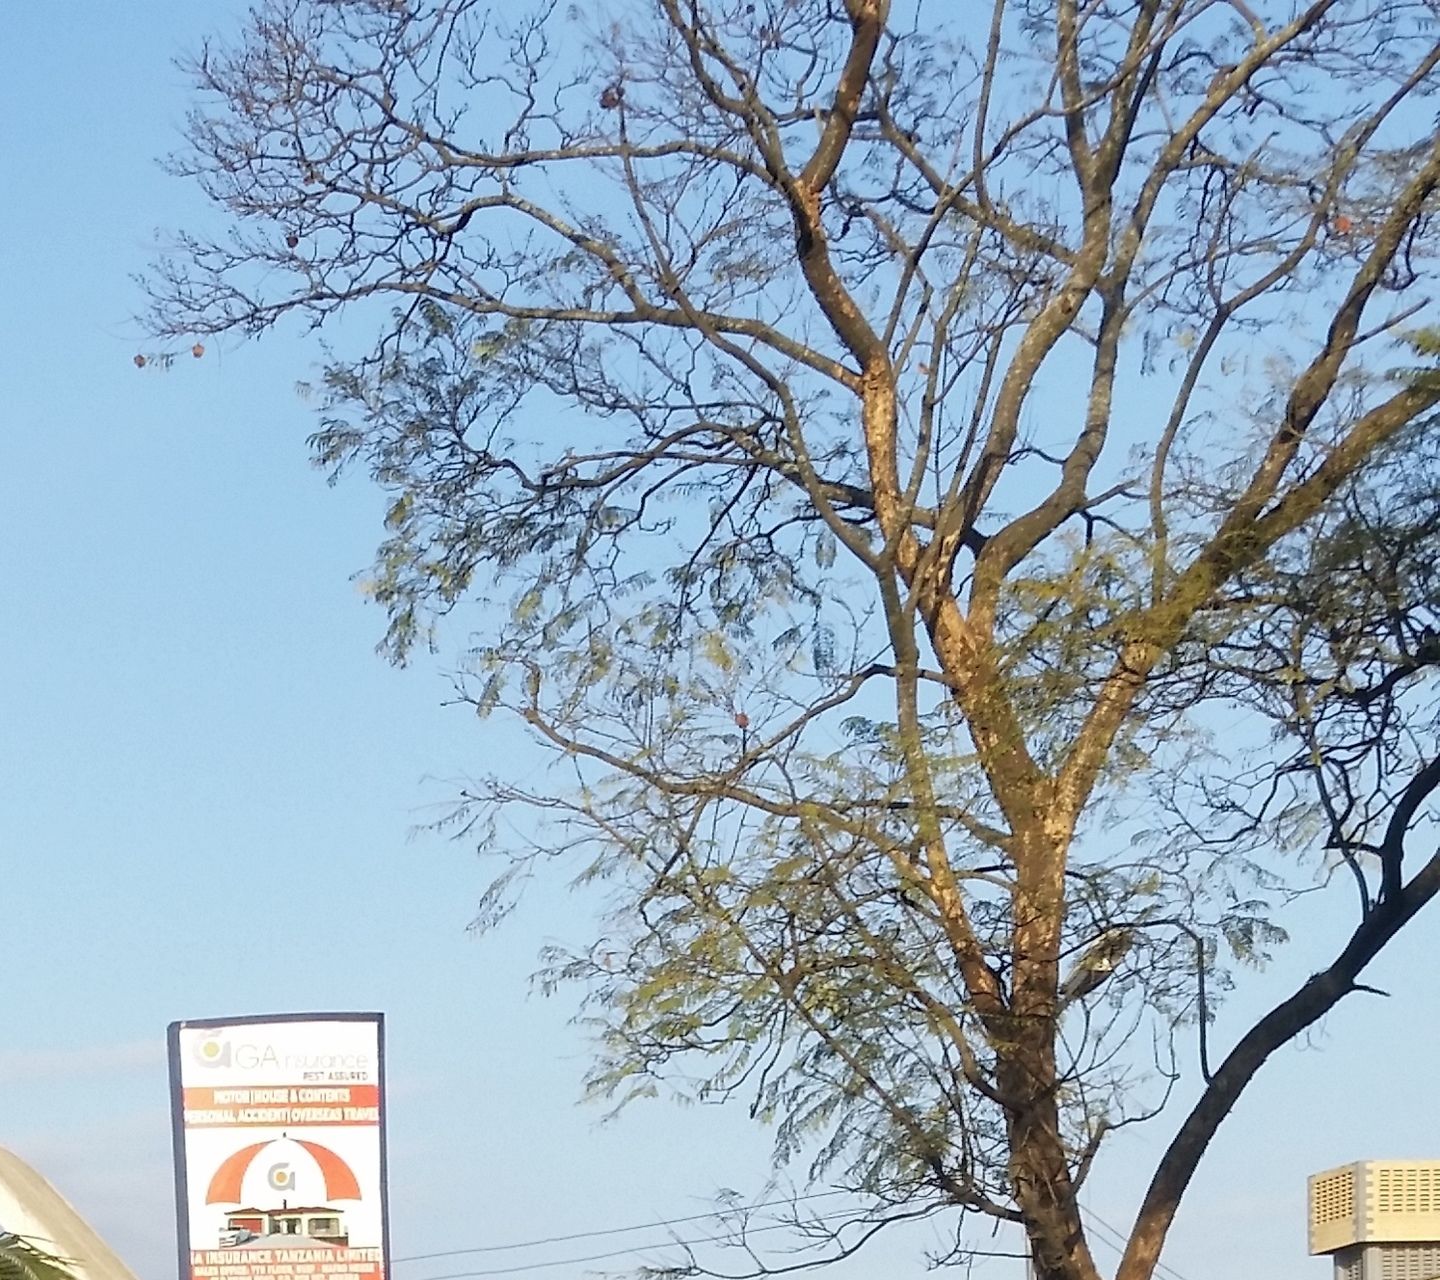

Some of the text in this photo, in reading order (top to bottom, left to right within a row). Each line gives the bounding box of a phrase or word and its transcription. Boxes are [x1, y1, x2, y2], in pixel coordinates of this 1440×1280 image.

[235, 1044, 369, 1070] GA nsurance
[303, 1071, 368, 1081] REST ASSURED
[254, 1089, 288, 1103] HOUSE
[299, 1088, 350, 1103] CONTENTS
[238, 1108, 286, 1122] ACCIDENT
[291, 1107, 342, 1121] OVERSEAS
[206, 1250, 272, 1264] INSURANCE
[275, 1249, 334, 1263] TANZANIA
